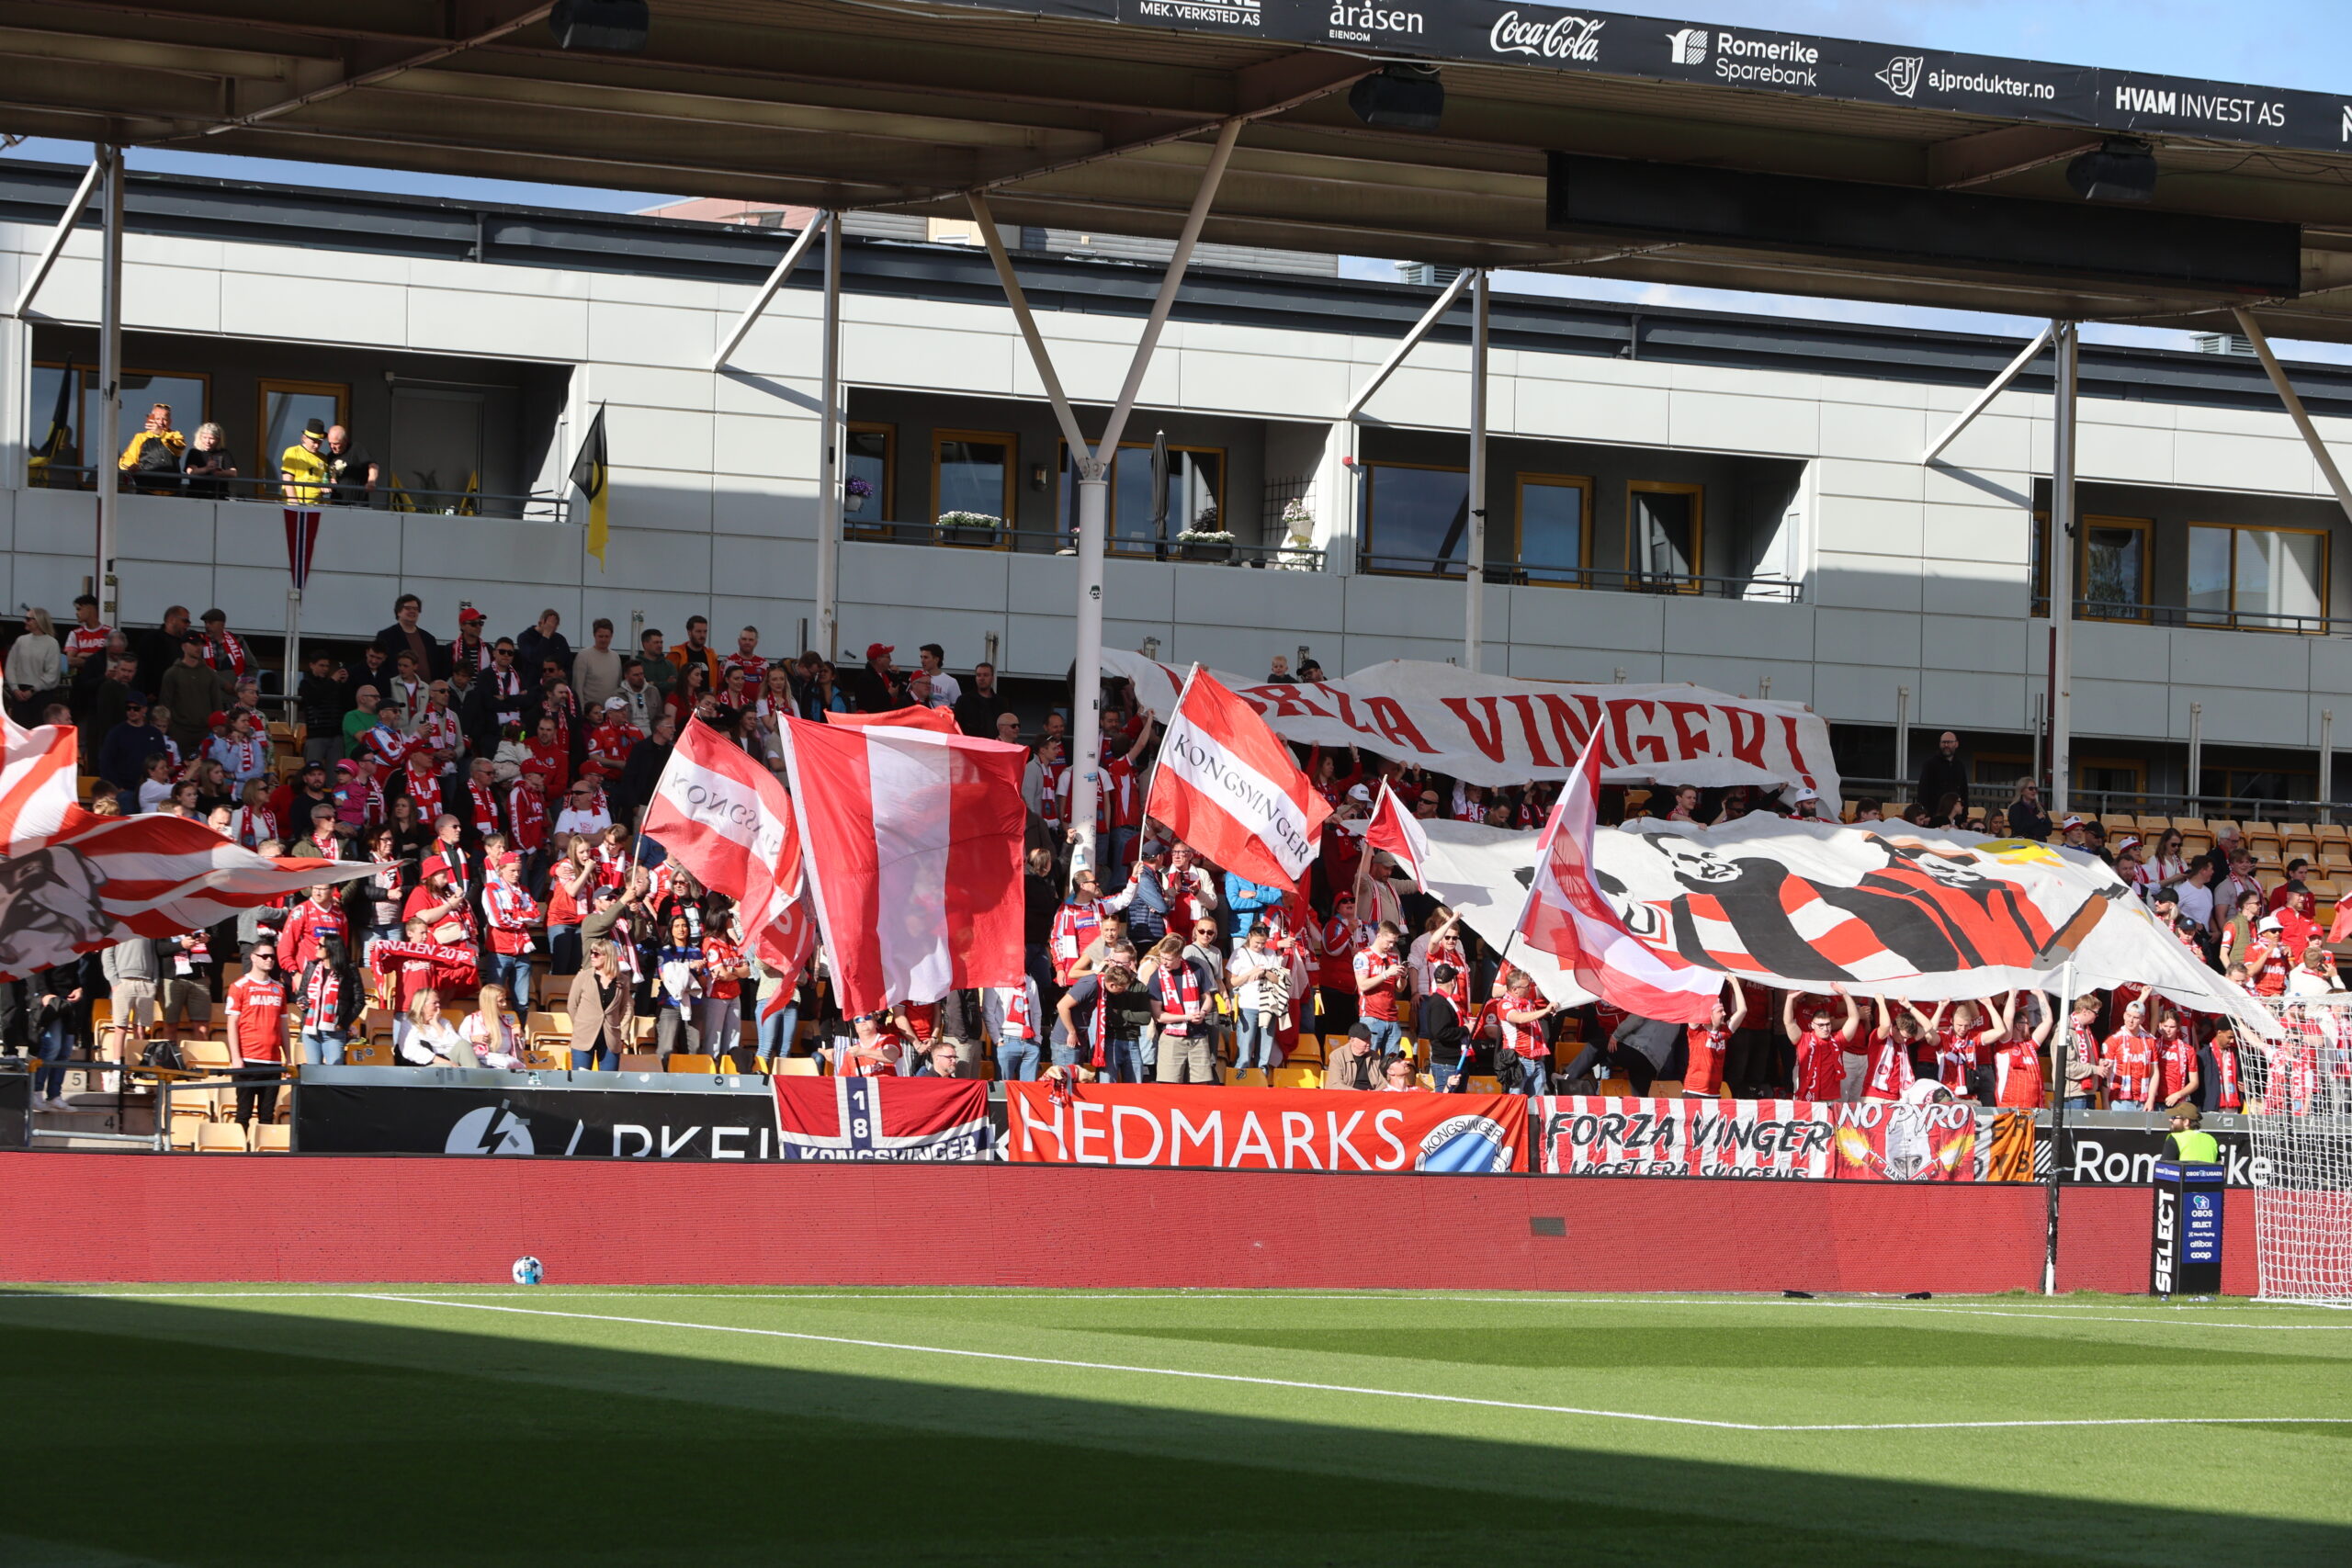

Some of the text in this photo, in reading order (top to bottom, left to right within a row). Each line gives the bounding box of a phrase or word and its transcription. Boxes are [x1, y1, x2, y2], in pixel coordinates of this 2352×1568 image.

[1140, 2, 1173, 17] MEK.
[1175, 6, 1239, 24] VERKSTED
[1242, 13, 1261, 26] AS
[1330, 0, 1423, 33] åråsen
[1329, 28, 1370, 42] EIENDOM
[1490, 10, 1606, 62] Coca-Cola
[1717, 31, 1819, 64] Romerike
[1715, 58, 1816, 87] Sparebank
[1928, 70, 2055, 99] ajprodukter.no
[2116, 85, 2285, 127] HVAM INVEST AS
[78, 637, 107, 649] MAPE
[1174, 733, 1310, 864] KONGSVINGER
[436, 946, 470, 962] 2016
[72, 1073, 82, 1086] 5
[104, 1115, 115, 1129] 4
[1020, 1091, 1406, 1171] HEDMARKS
[1838, 1102, 1969, 1136] NO PYRO
[800, 1134, 977, 1160] KONGSVINGER
[1424, 1118, 1503, 1155] KONGSVINGER
[1545, 1112, 1834, 1158] FORZA VINGER
[2155, 1189, 2175, 1293] SELECT
[2190, 1251, 2212, 1259] coop
